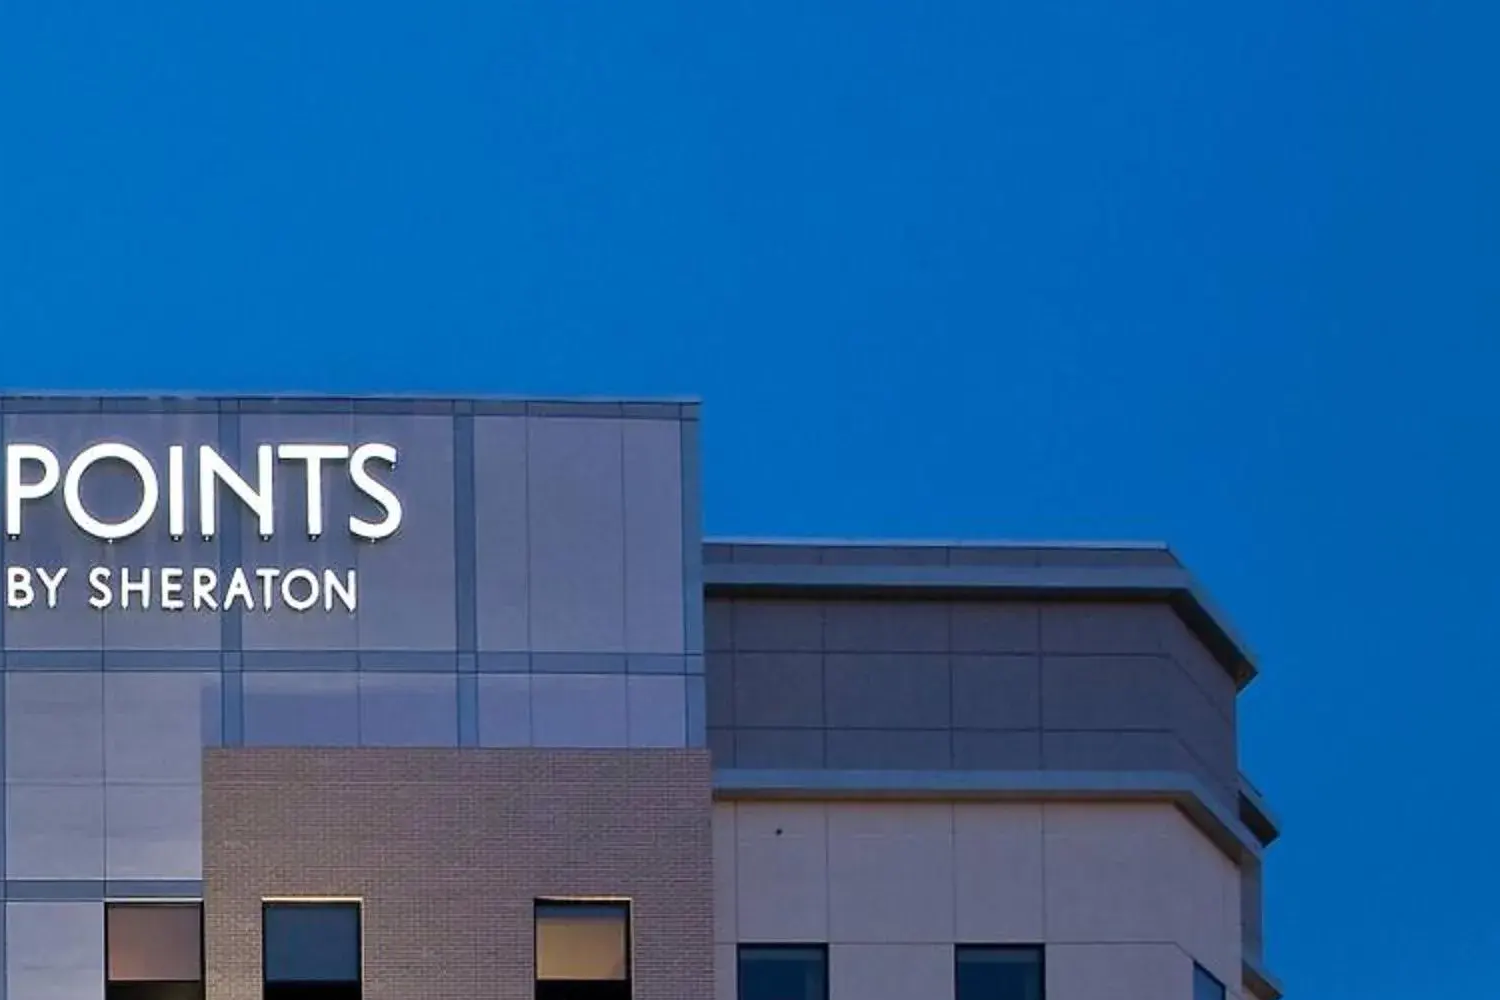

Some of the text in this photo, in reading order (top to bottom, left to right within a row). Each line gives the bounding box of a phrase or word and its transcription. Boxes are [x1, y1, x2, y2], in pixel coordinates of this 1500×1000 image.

[7, 443, 403, 539] POINTS
[7, 566, 357, 612] BY SHERATON
